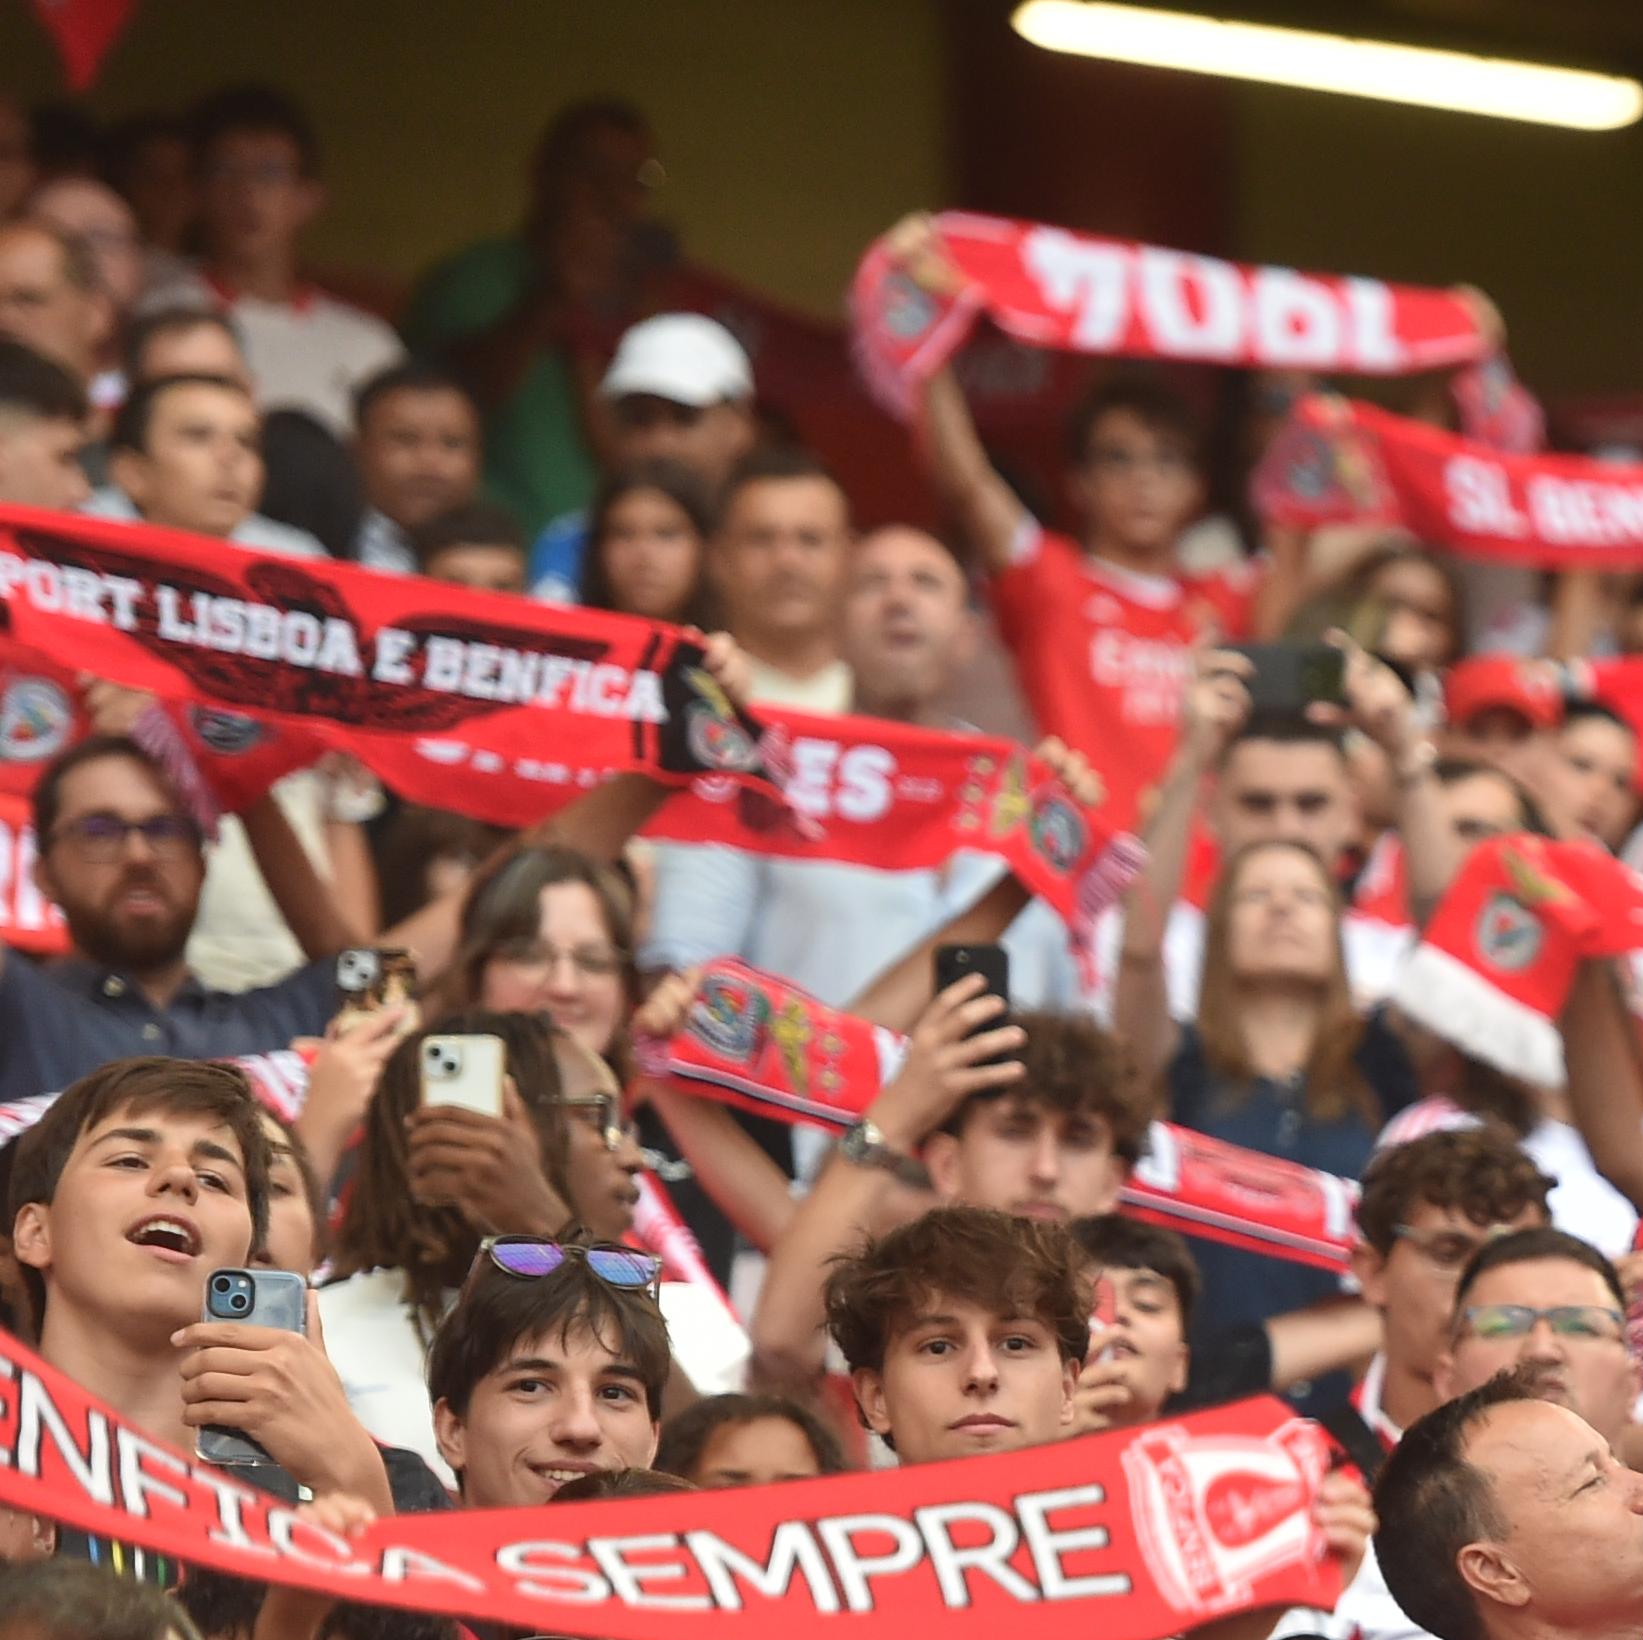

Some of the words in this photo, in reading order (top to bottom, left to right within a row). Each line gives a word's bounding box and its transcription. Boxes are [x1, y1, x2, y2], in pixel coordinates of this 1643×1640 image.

[1021, 227, 1400, 372] 1904
[155, 588, 365, 678] LISBOA
[373, 626, 419, 687] E
[423, 636, 670, 725] BENFICA
[497, 1484, 1131, 1613] SEMPRE
